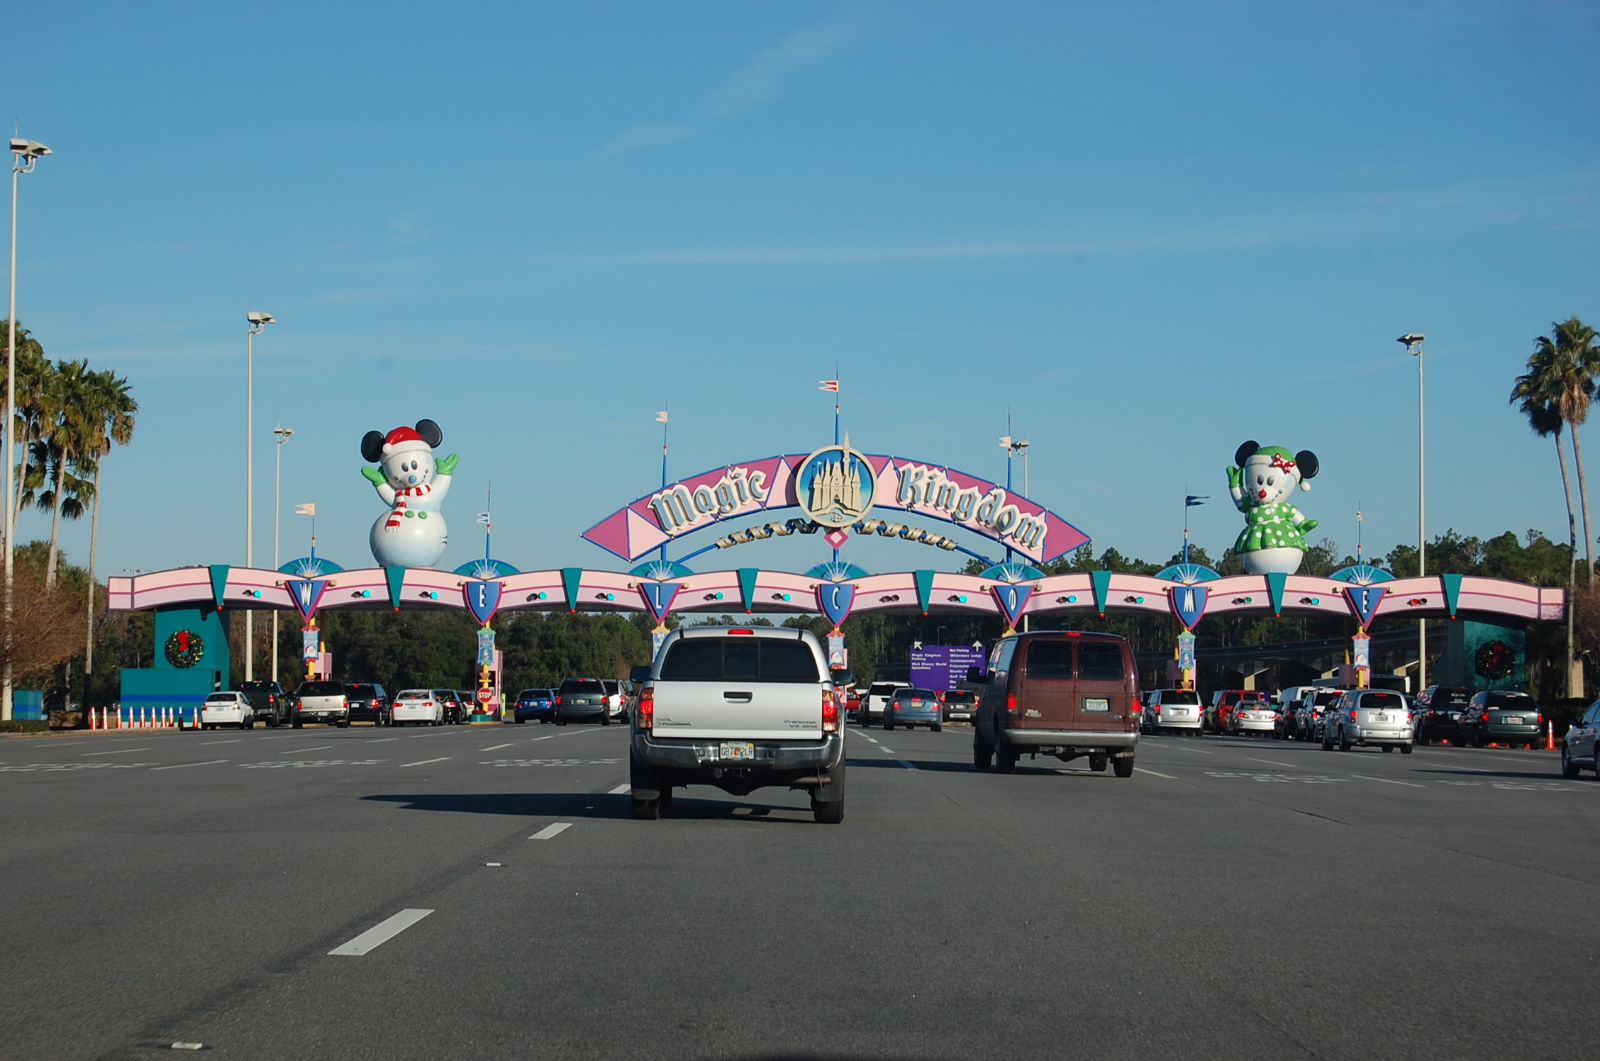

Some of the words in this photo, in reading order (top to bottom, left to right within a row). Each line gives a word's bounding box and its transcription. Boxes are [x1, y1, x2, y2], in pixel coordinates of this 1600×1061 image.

[648, 467, 769, 532] Magic
[896, 464, 1047, 551] Kingdom
[299, 582, 314, 606] W
[480, 584, 487, 607] E
[656, 586, 663, 609] L
[832, 587, 840, 610] C
[1183, 589, 1196, 613] M
[1362, 590, 1369, 613] E
